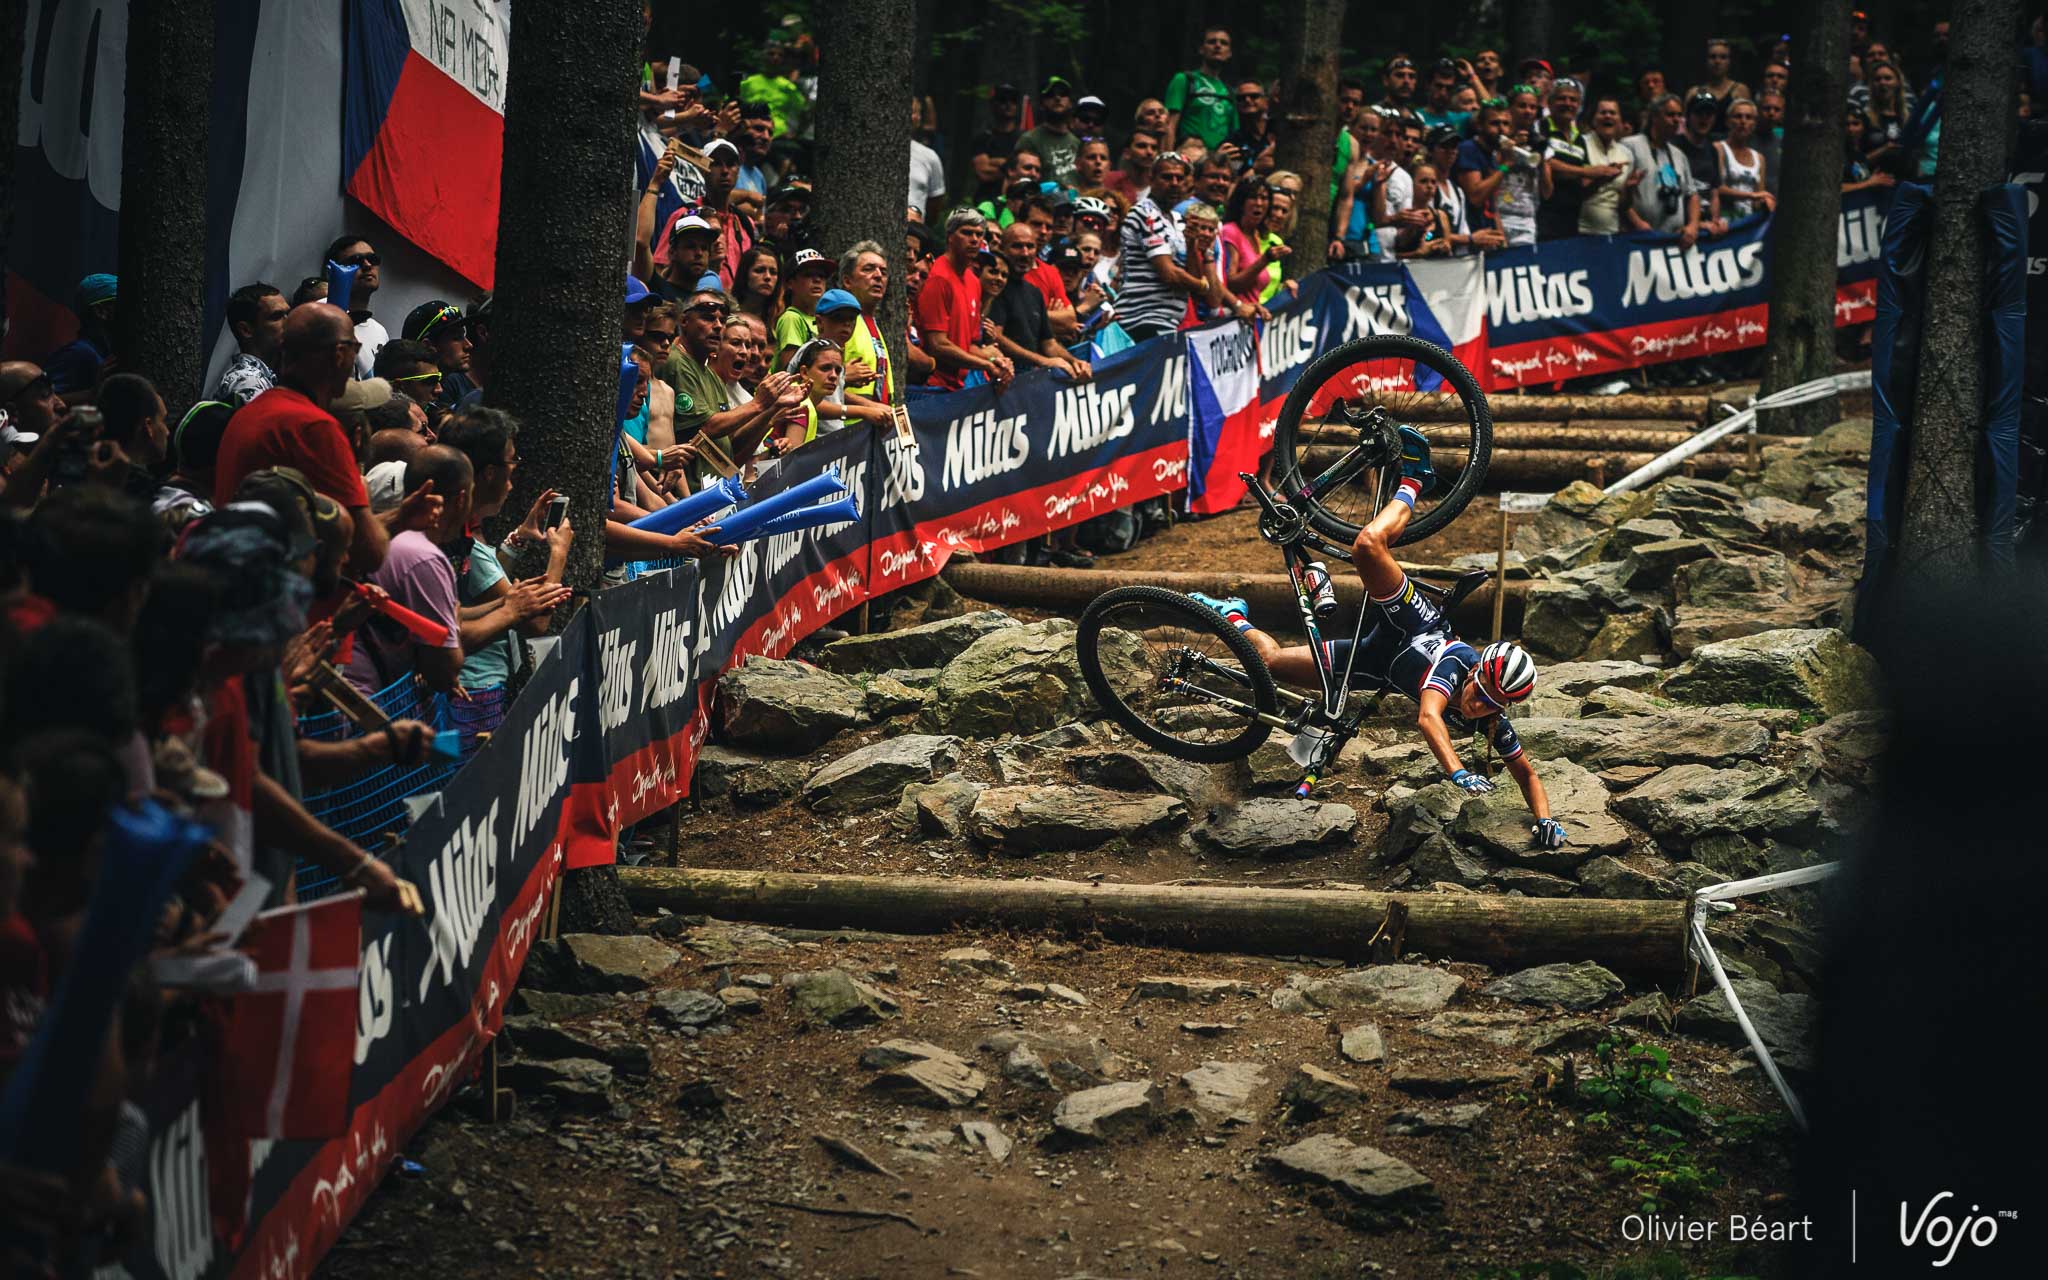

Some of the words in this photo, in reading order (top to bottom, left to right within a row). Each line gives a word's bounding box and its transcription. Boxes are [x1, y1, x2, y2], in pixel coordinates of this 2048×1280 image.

[462, 19, 504, 110] MOR
[1486, 265, 1593, 328] Mitas
[1621, 241, 1763, 309] Mitas
[1342, 283, 1413, 345] Mit
[1631, 326, 1699, 357] Designed
[1702, 321, 1733, 350] for
[1735, 317, 1765, 344] You
[1545, 346, 1571, 377] for
[1572, 344, 1598, 372] You
[942, 408, 1029, 493] Mitas
[1047, 382, 1136, 461] Mitas
[419, 797, 499, 1004] Mitas
